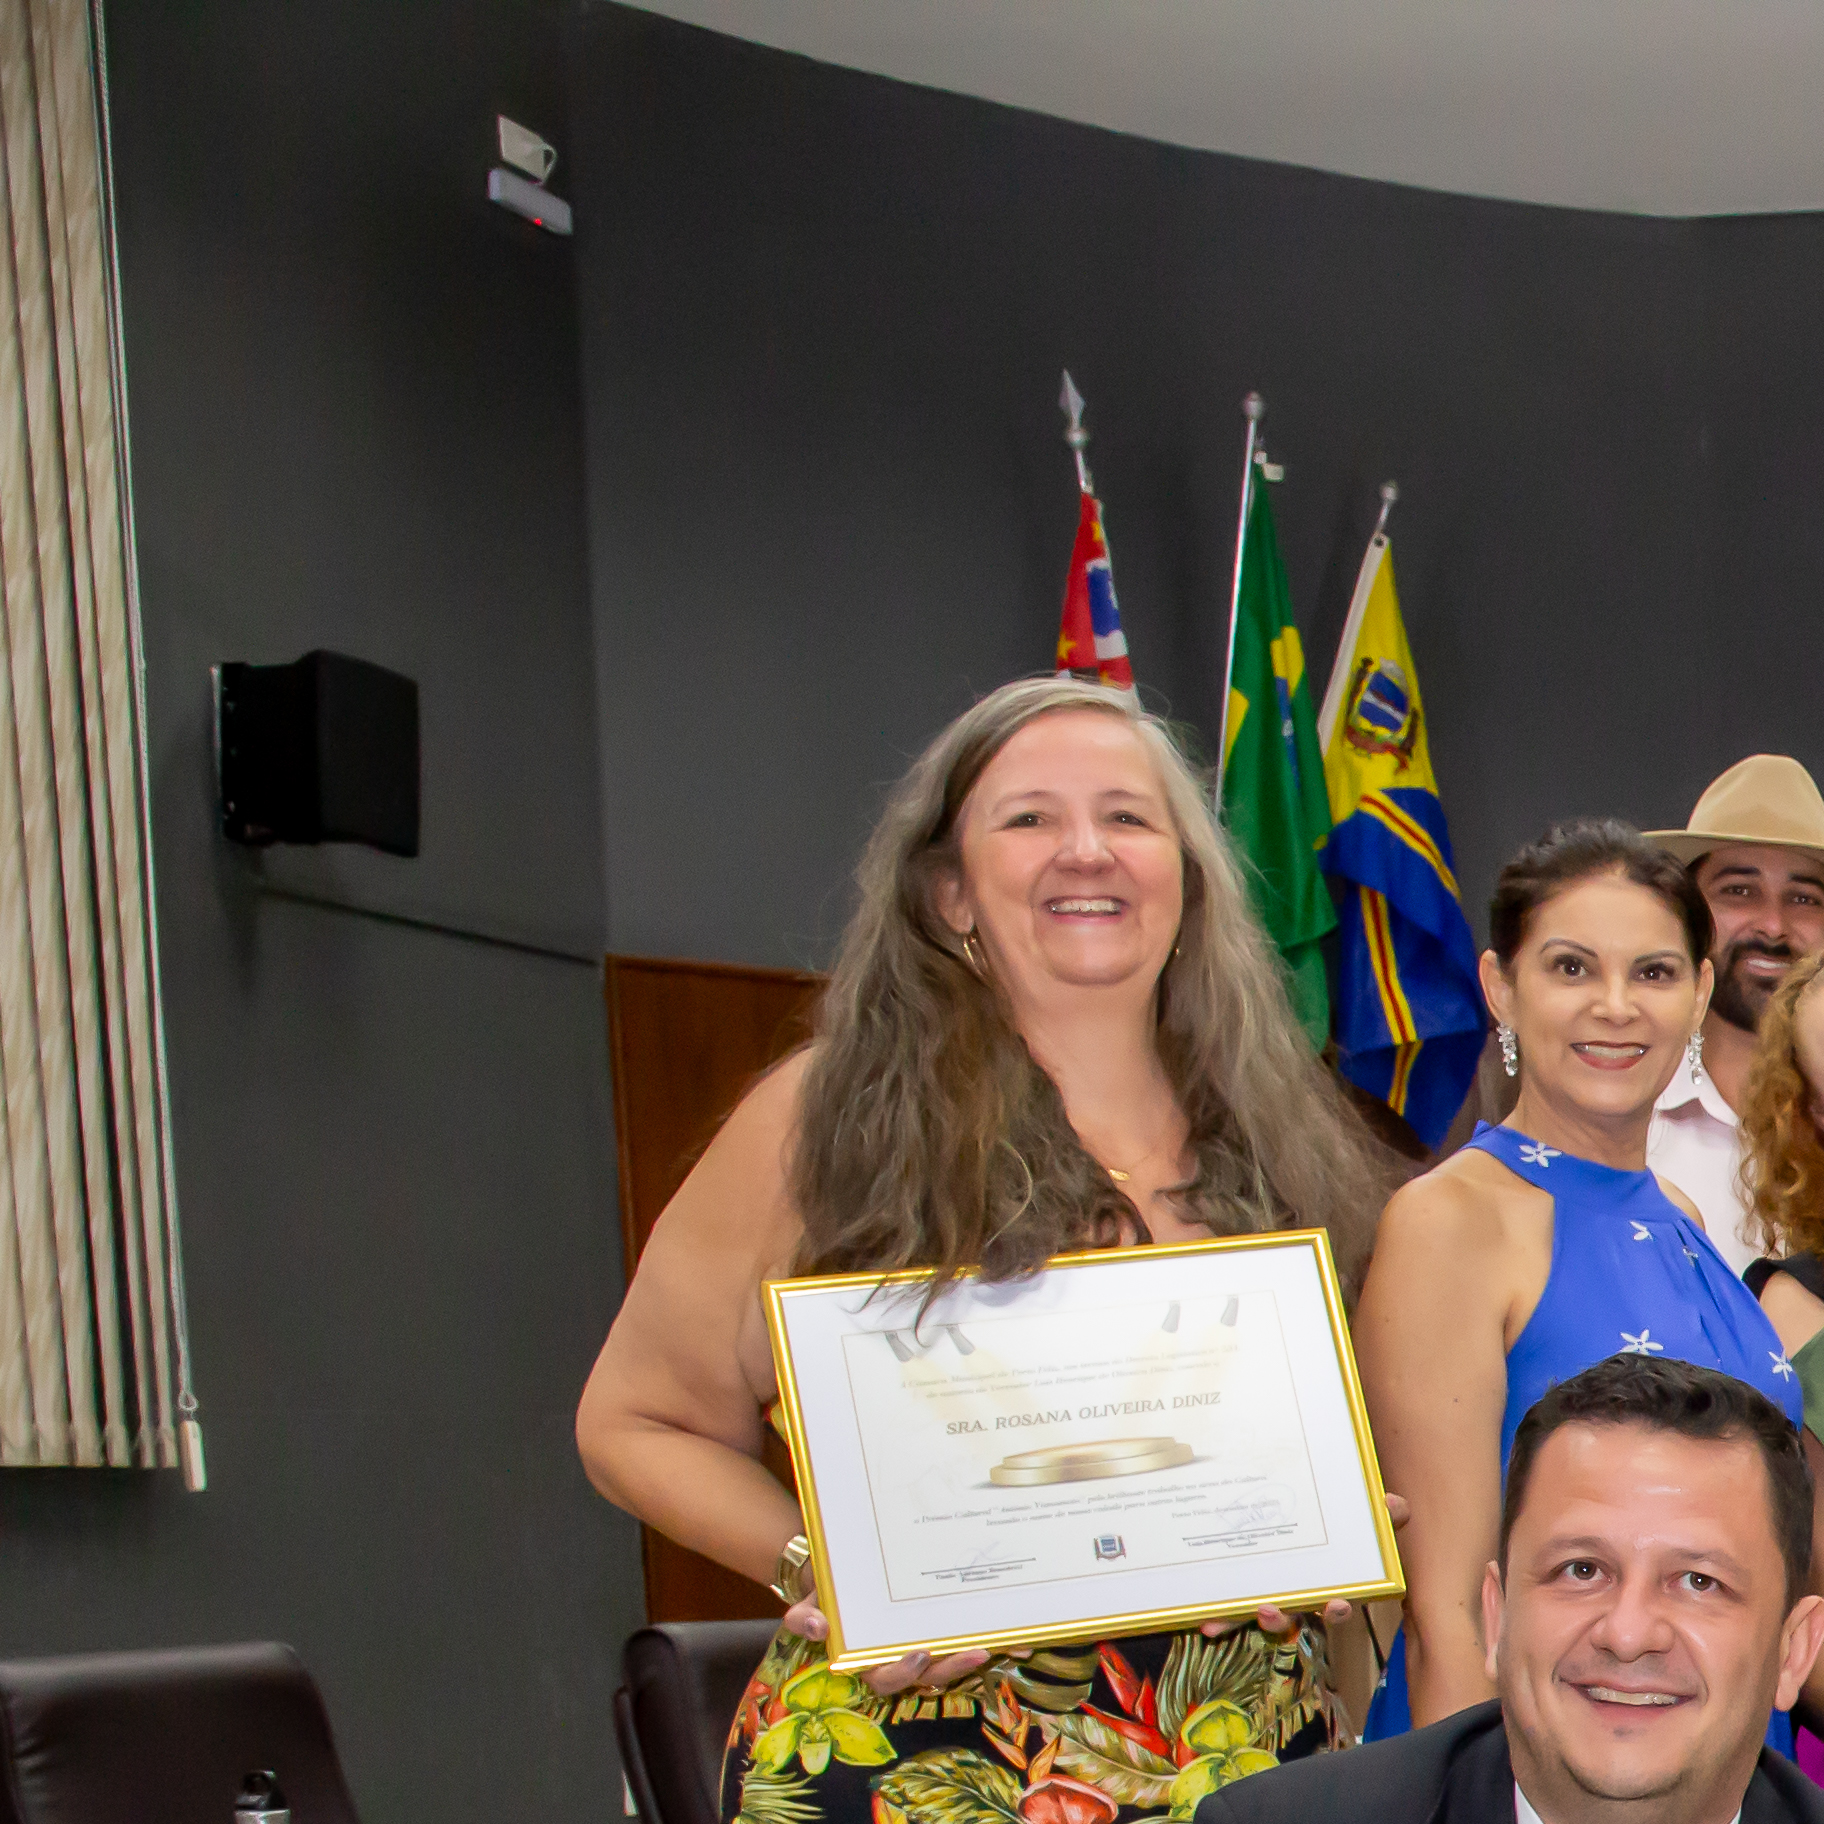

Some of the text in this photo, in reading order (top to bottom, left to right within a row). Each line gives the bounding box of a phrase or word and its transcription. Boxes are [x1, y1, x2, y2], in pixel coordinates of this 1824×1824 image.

[947, 1393, 1220, 1436] SRA. ROSANA OLIVEIRA DINIZ
